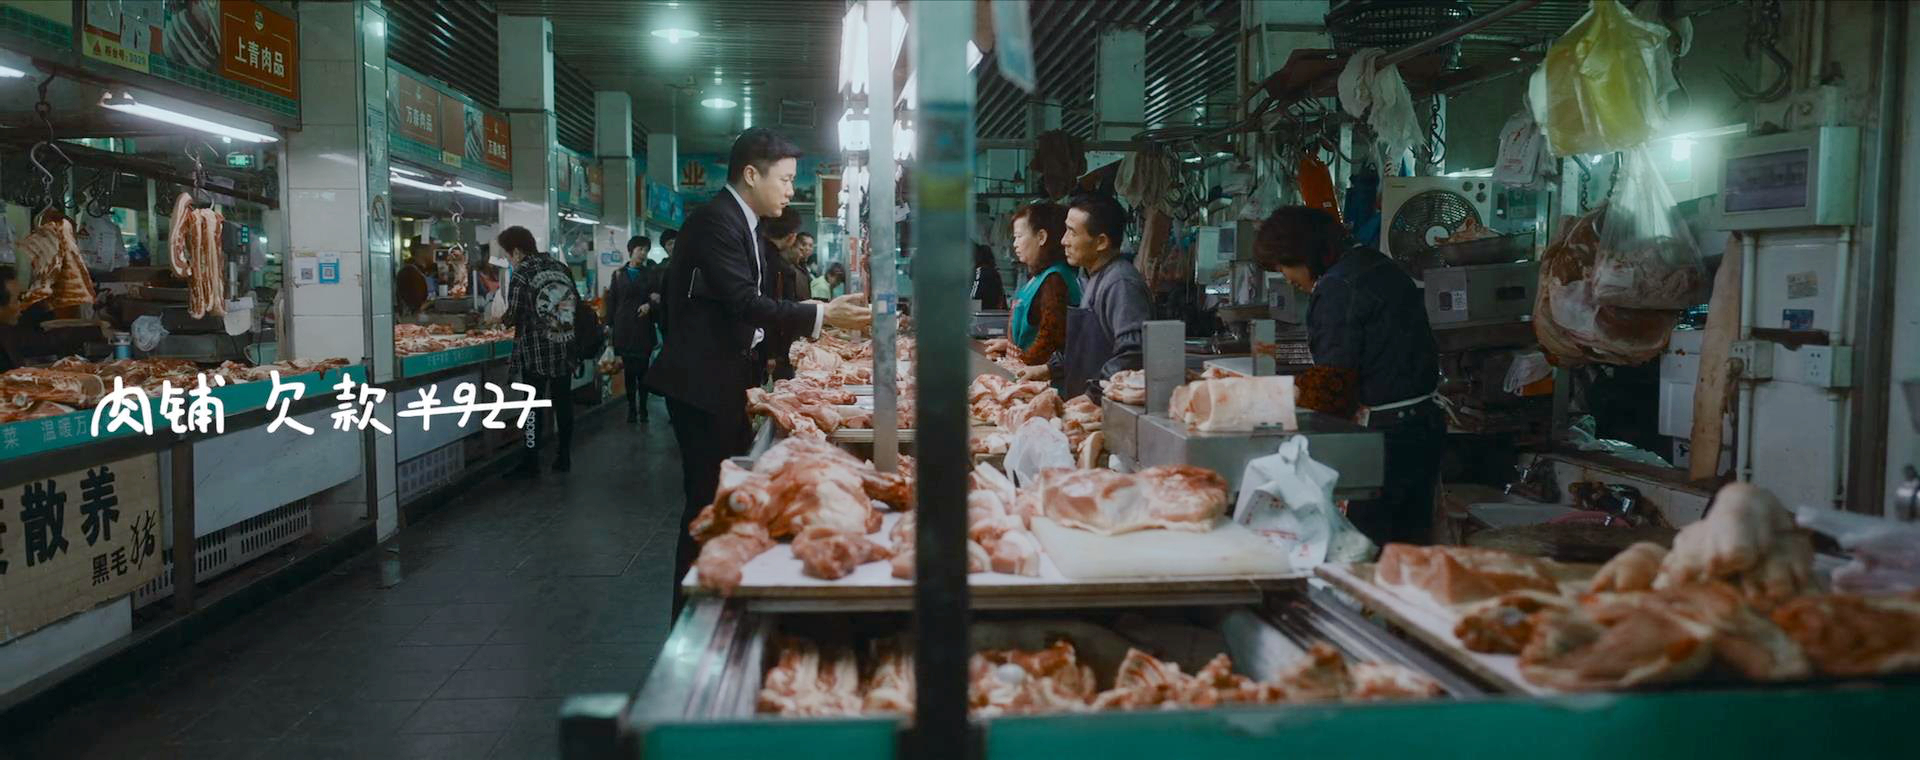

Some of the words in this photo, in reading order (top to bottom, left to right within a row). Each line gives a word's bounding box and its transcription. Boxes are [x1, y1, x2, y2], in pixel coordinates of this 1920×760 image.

[234, 36, 285, 78] 上青肉品
[0, 466, 120, 574] 散养
